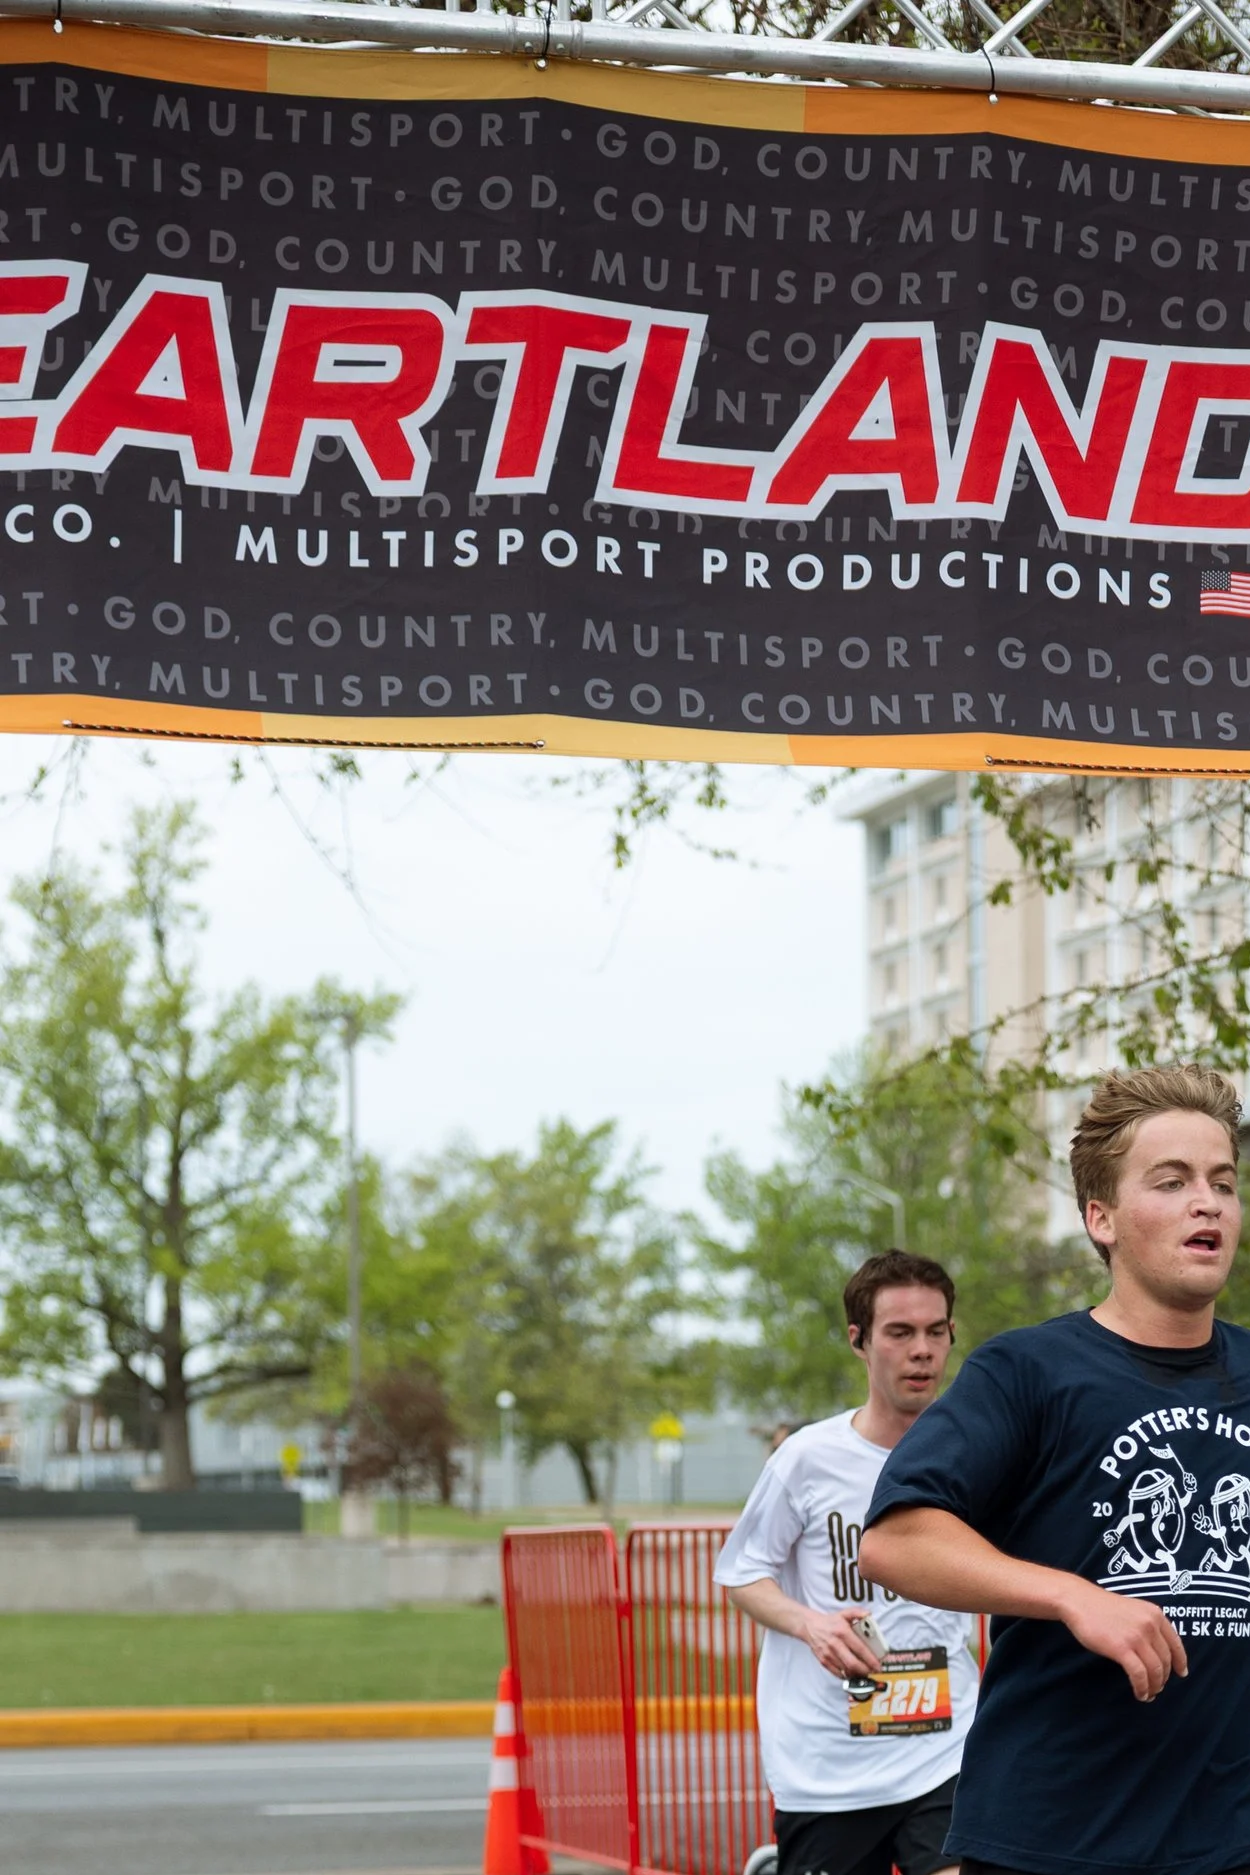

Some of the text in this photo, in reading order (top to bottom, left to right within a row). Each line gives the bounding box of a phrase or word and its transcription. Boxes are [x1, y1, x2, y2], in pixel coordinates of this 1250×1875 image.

[152, 94, 541, 148] MULTISPORT
[596, 123, 729, 176] GOD,
[756, 143, 1033, 189] COUNTRY,
[430, 174, 566, 216] GOD,
[593, 186, 873, 247] COUNTRY,
[107, 216, 246, 269] GOD,
[275, 235, 564, 278] COUNTRY,
[590, 248, 958, 306] MULTISPORT
[1010, 276, 1133, 329] GOD,
[4, 503, 121, 549] CO.
[235, 523, 661, 579] MULTISPORT
[702, 546, 1172, 609] PRODUCTIONS
[103, 595, 240, 645] GOD,
[268, 611, 556, 649] COUNTRY,
[581, 618, 944, 670] MULTISPORT
[997, 636, 1122, 684] GOD,
[148, 660, 528, 708] MULTISPORT
[583, 677, 715, 723] GOD,
[740, 691, 1016, 728] COUNTRY,
[1100, 1406, 1209, 1480] POTTER'S
[1162, 1606, 1248, 1619] PROFFITT LEGACY
[1191, 1620, 1211, 1637] 5K
[1227, 1621, 1250, 1638] FUN
[870, 1677, 939, 1717] 2279
